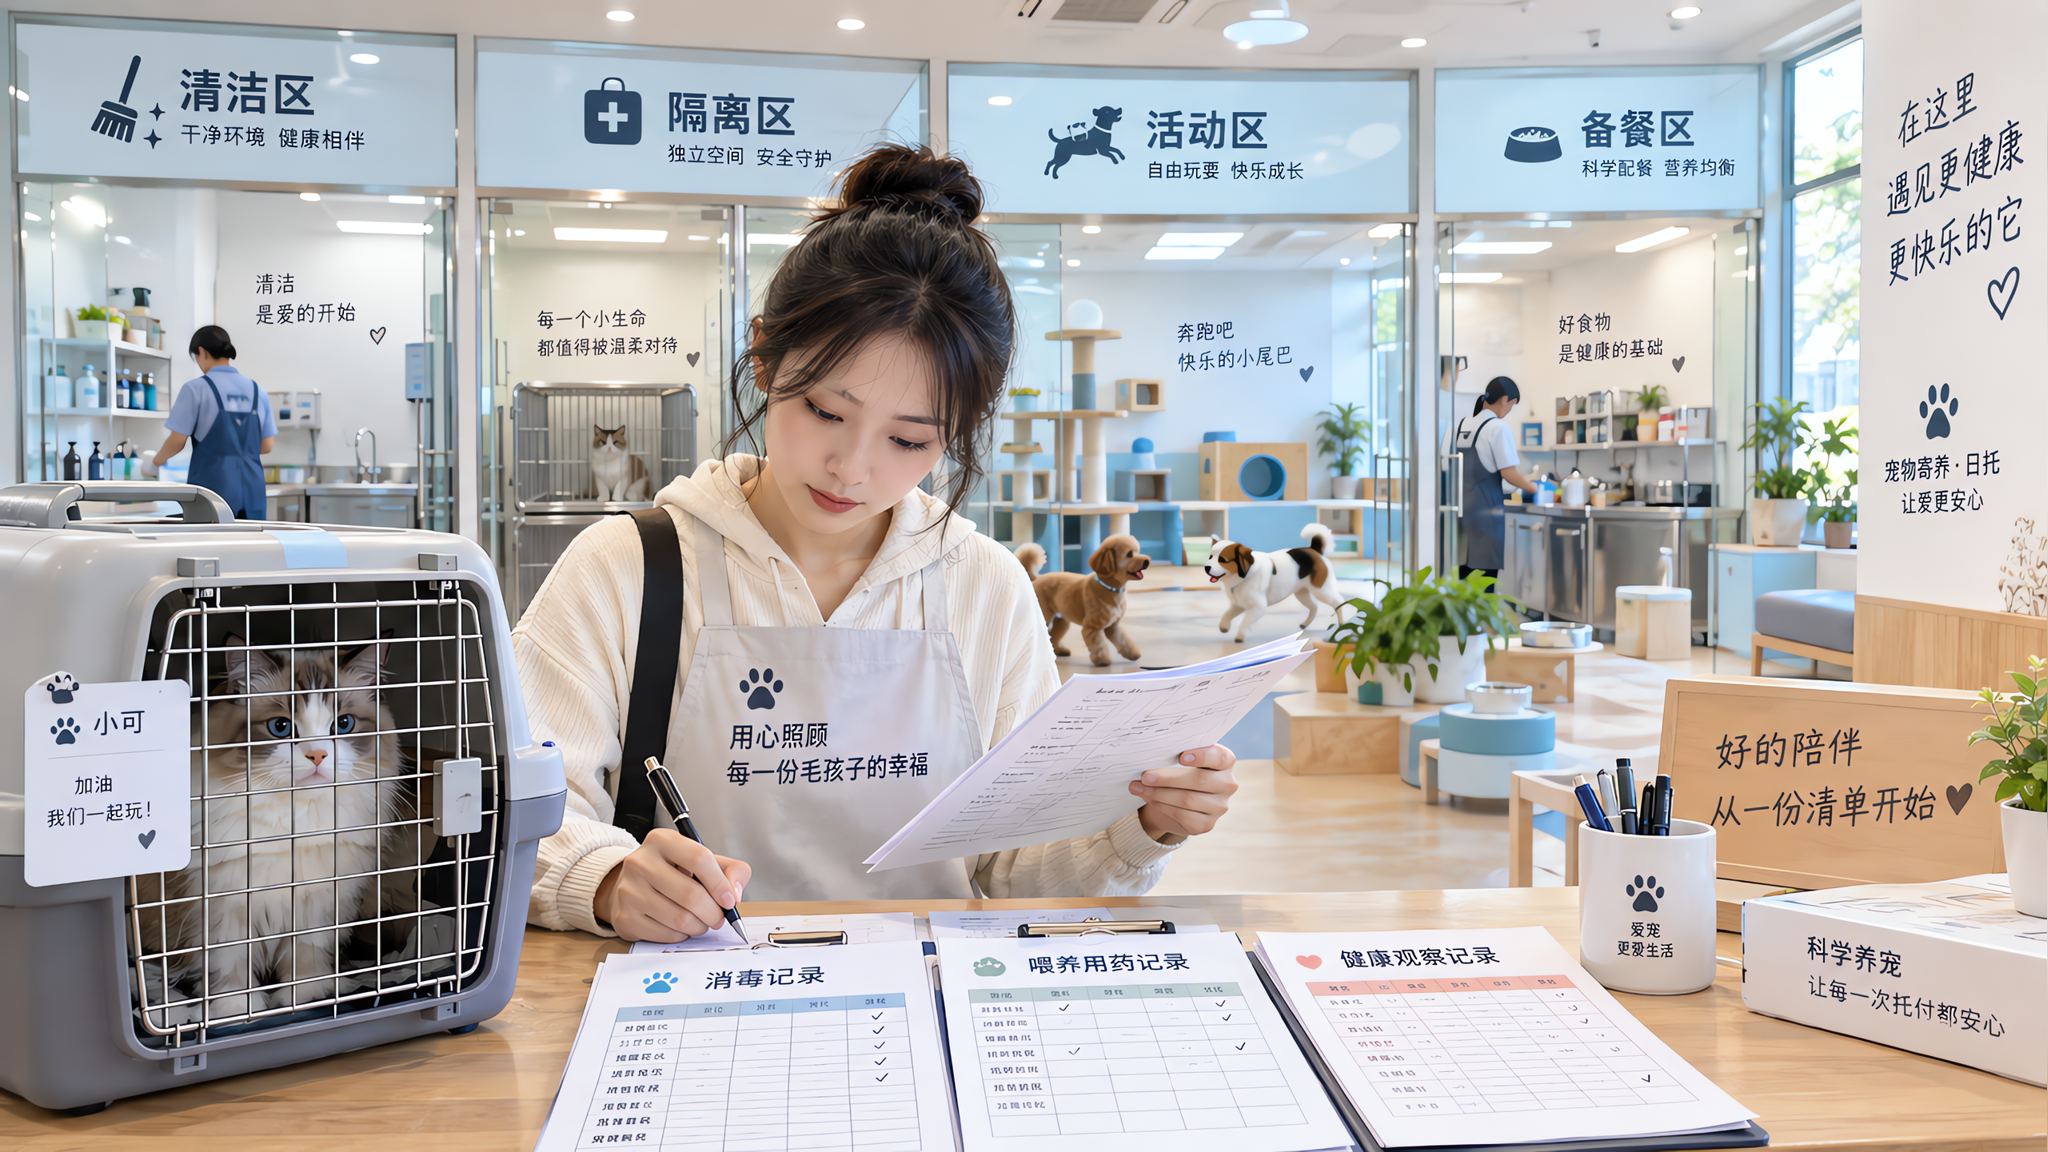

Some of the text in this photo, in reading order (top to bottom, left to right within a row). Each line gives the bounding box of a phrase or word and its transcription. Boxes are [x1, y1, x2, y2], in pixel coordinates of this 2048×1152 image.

[180, 69, 314, 115] 清洁区
[669, 92, 795, 135] 隔离区
[1898, 73, 1977, 147] 在这里
[181, 125, 364, 150] 干净环境 健康相伴
[1147, 110, 1267, 149] 活动区
[1582, 110, 1694, 148] 备餐区
[668, 145, 831, 168] 独立空间 安全守护
[1582, 159, 1734, 177] 科学配餐 营养均衡
[1887, 120, 2024, 217] 遇见更健康
[1231, 162, 1303, 179] 快乐成长
[1889, 196, 2022, 286] 更快乐的它
[257, 273, 294, 294] 清洁
[257, 303, 355, 324] 是爱的开始
[538, 309, 646, 329] 每一个小生命
[1559, 313, 1610, 334] 好食物
[1178, 322, 1234, 342] 奔跑吧
[538, 337, 677, 356] 都值得被温柔对待
[1178, 346, 1292, 372] 快乐的小尾巴
[1902, 488, 1983, 513] 让爱更安心
[94, 711, 145, 735] 小可
[730, 723, 828, 749] 用心照顾
[1716, 728, 1862, 769] 好的陪伴
[727, 752, 929, 786] 每一份毛孩子的幸福
[75, 775, 112, 794] 加油
[1711, 785, 1936, 827] 从一份清单开始
[1631, 922, 1661, 938] 爱宠
[1029, 954, 1189, 974] 喂养用药记录
[1341, 947, 1500, 968] 健康观察记录
[1807, 936, 1902, 977] 科学养宠
[706, 967, 824, 989] 消毒记录
[1808, 975, 2005, 1037] 让每一次托付都安心
